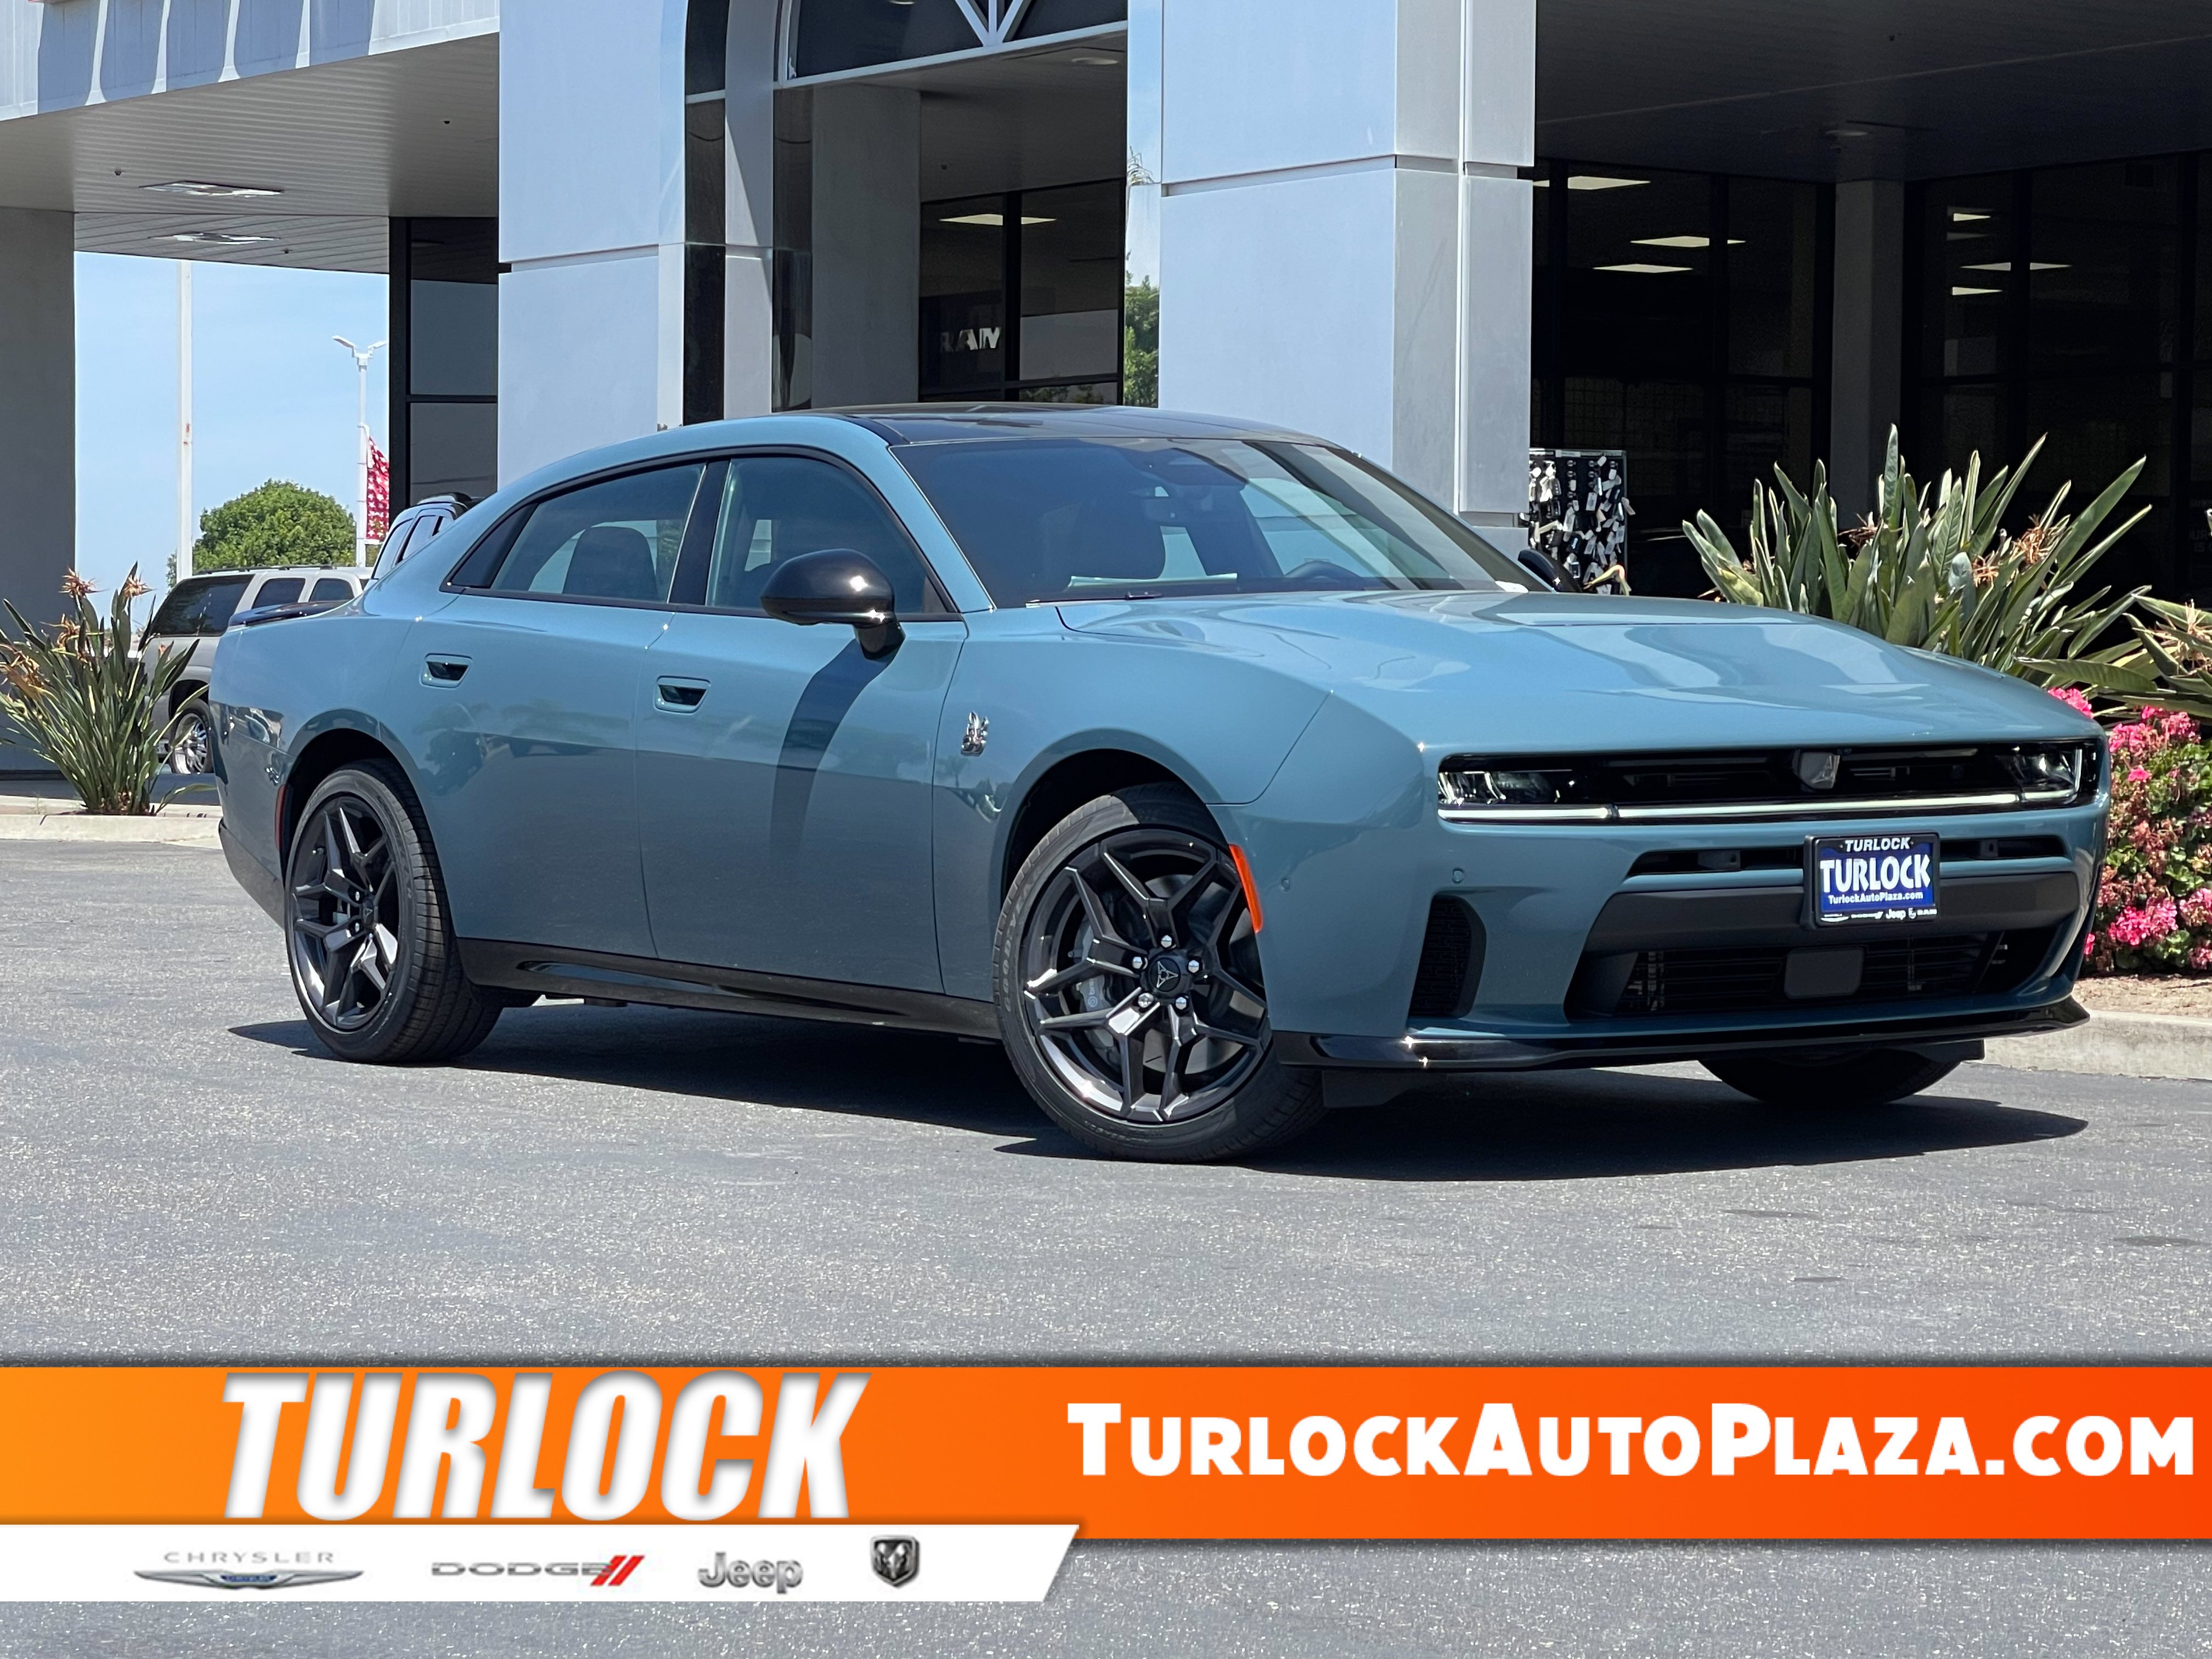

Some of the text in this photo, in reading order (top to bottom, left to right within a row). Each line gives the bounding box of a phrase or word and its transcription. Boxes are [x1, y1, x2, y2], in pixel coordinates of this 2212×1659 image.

[1845, 837, 1910, 852] TURLOCK
[1820, 854, 1931, 893] TURLOCK
[1828, 891, 1923, 904] TurlockAutoPlaza.com
